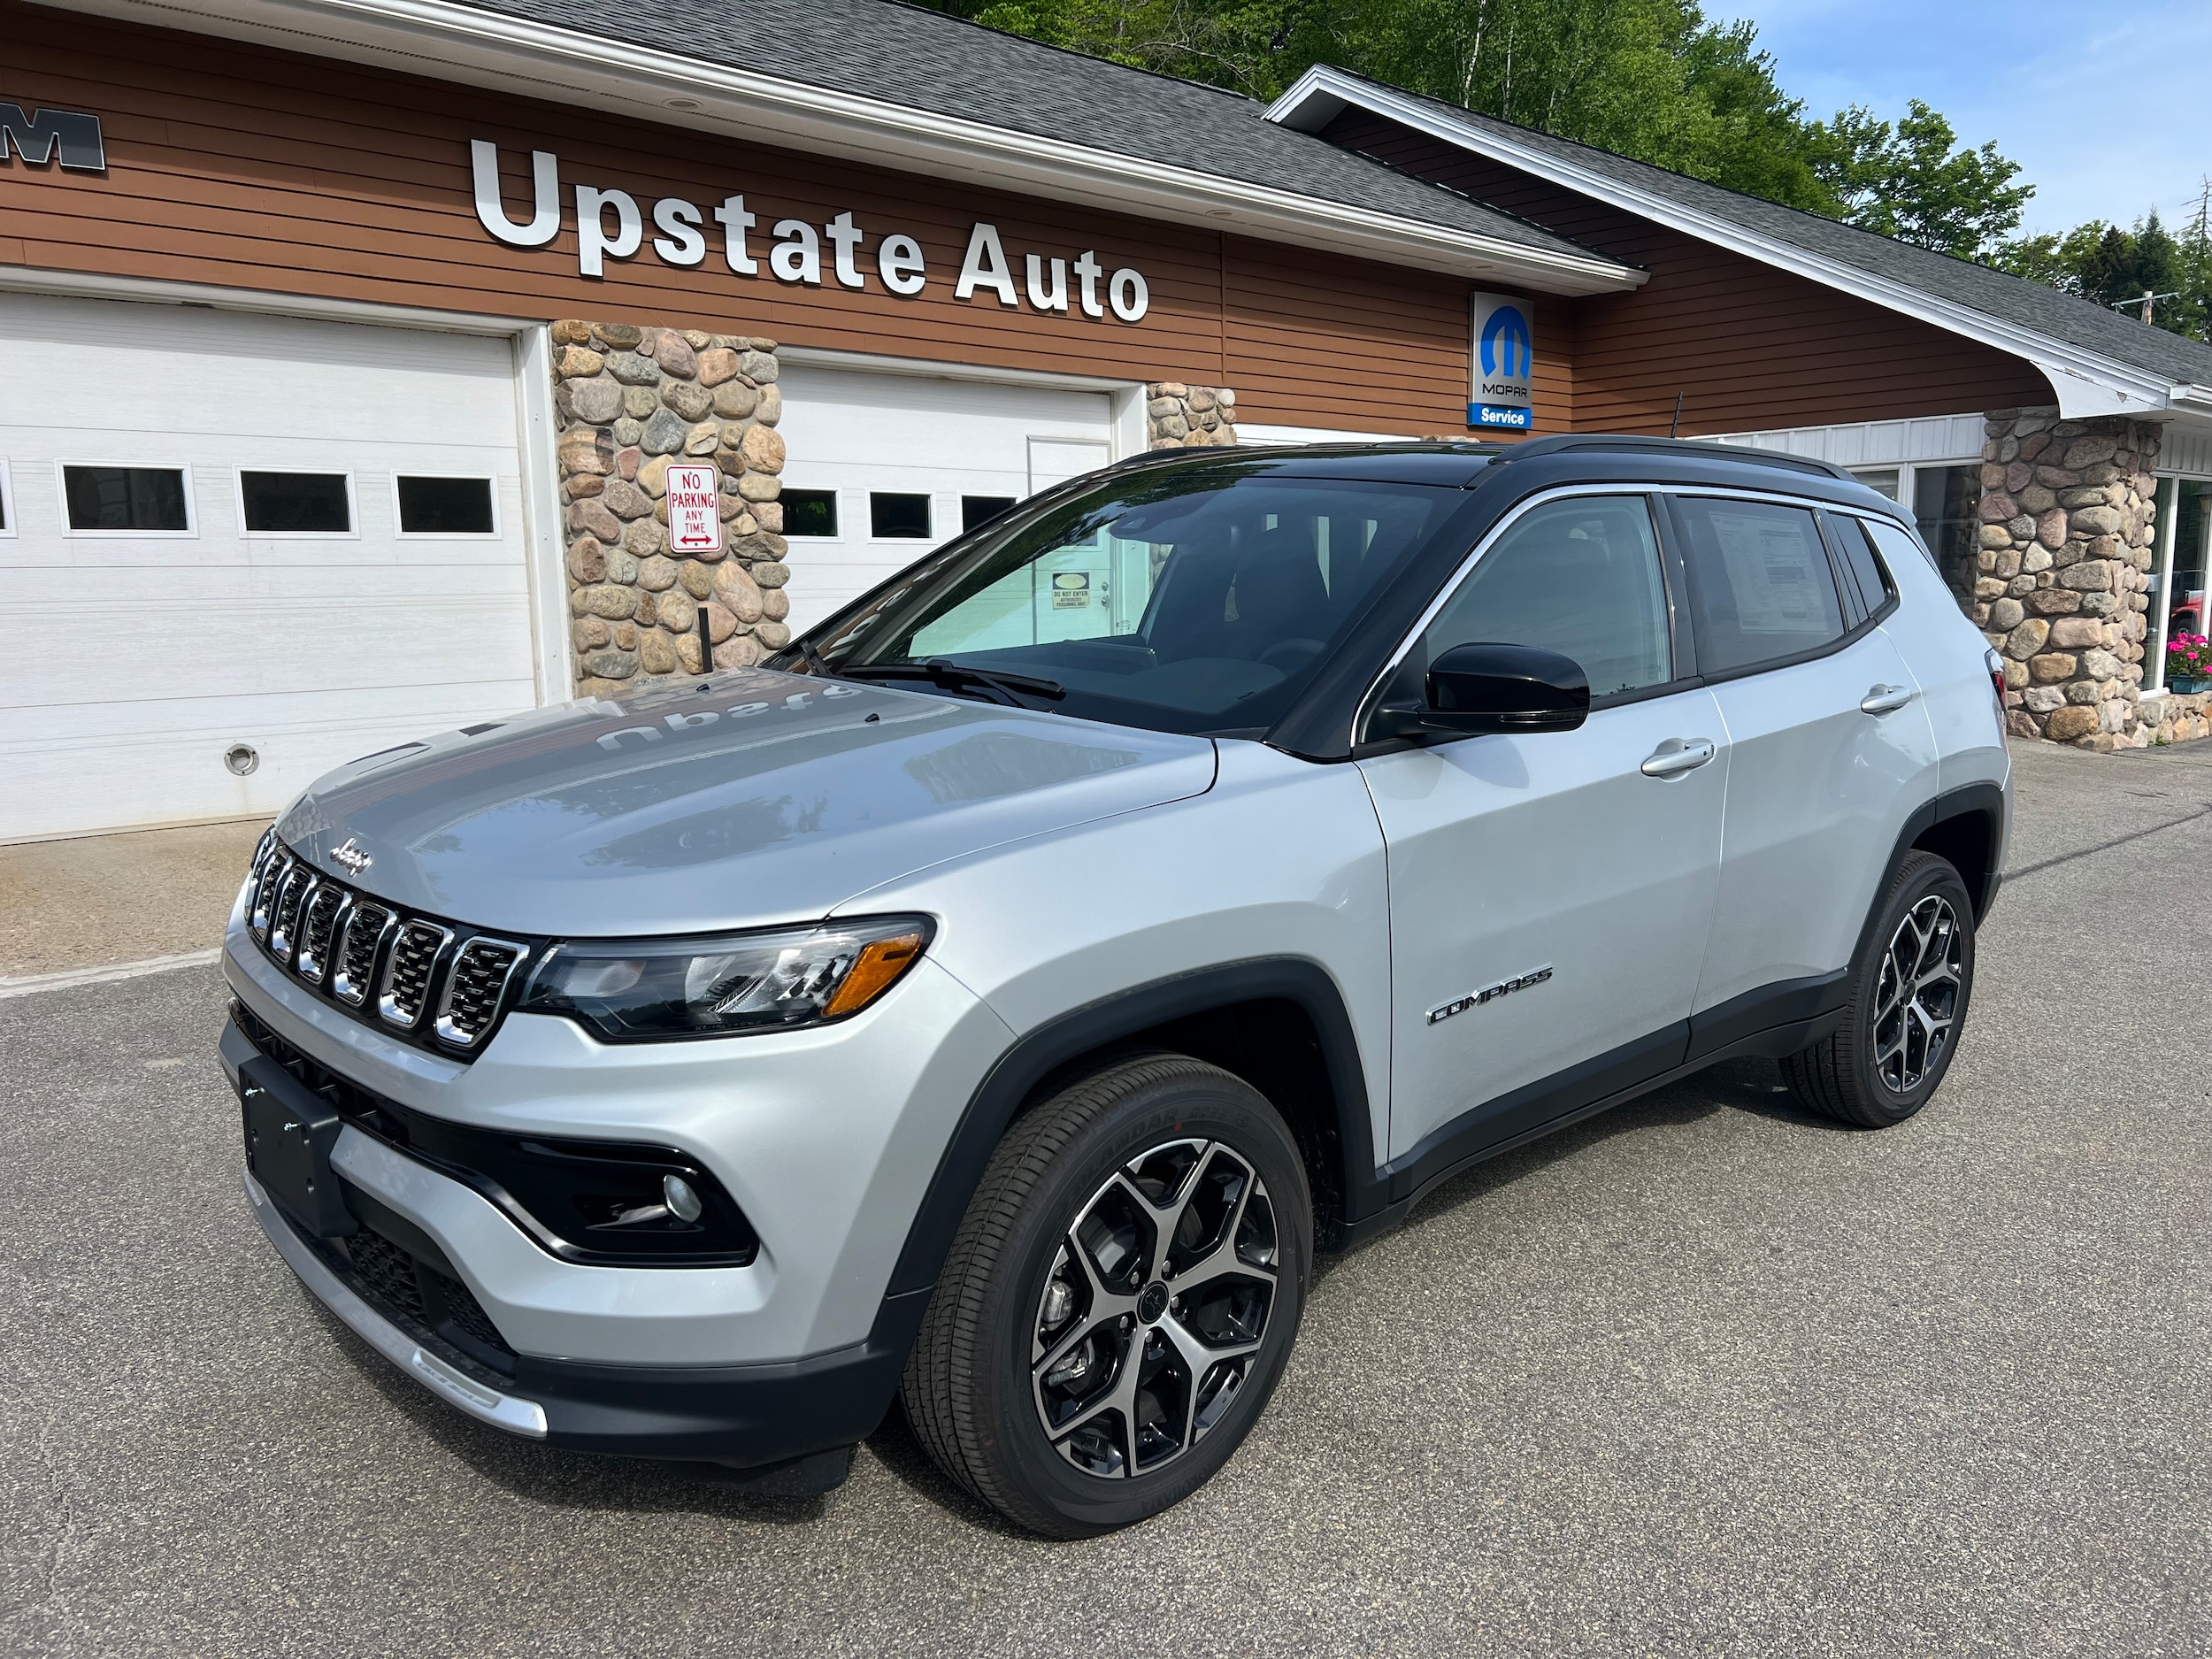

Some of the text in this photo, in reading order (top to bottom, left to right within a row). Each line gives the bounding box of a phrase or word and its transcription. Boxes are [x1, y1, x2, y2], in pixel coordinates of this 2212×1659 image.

[469, 139, 1150, 321] Upstate Auto
[1482, 383, 1528, 398] MOPAR
[1480, 407, 1525, 425] Service
[682, 473, 701, 489] NO
[672, 493, 714, 508] PARKING
[685, 511, 703, 520] ANY
[685, 523, 706, 534] TIME
[1425, 963, 1553, 1026] COMPASS
